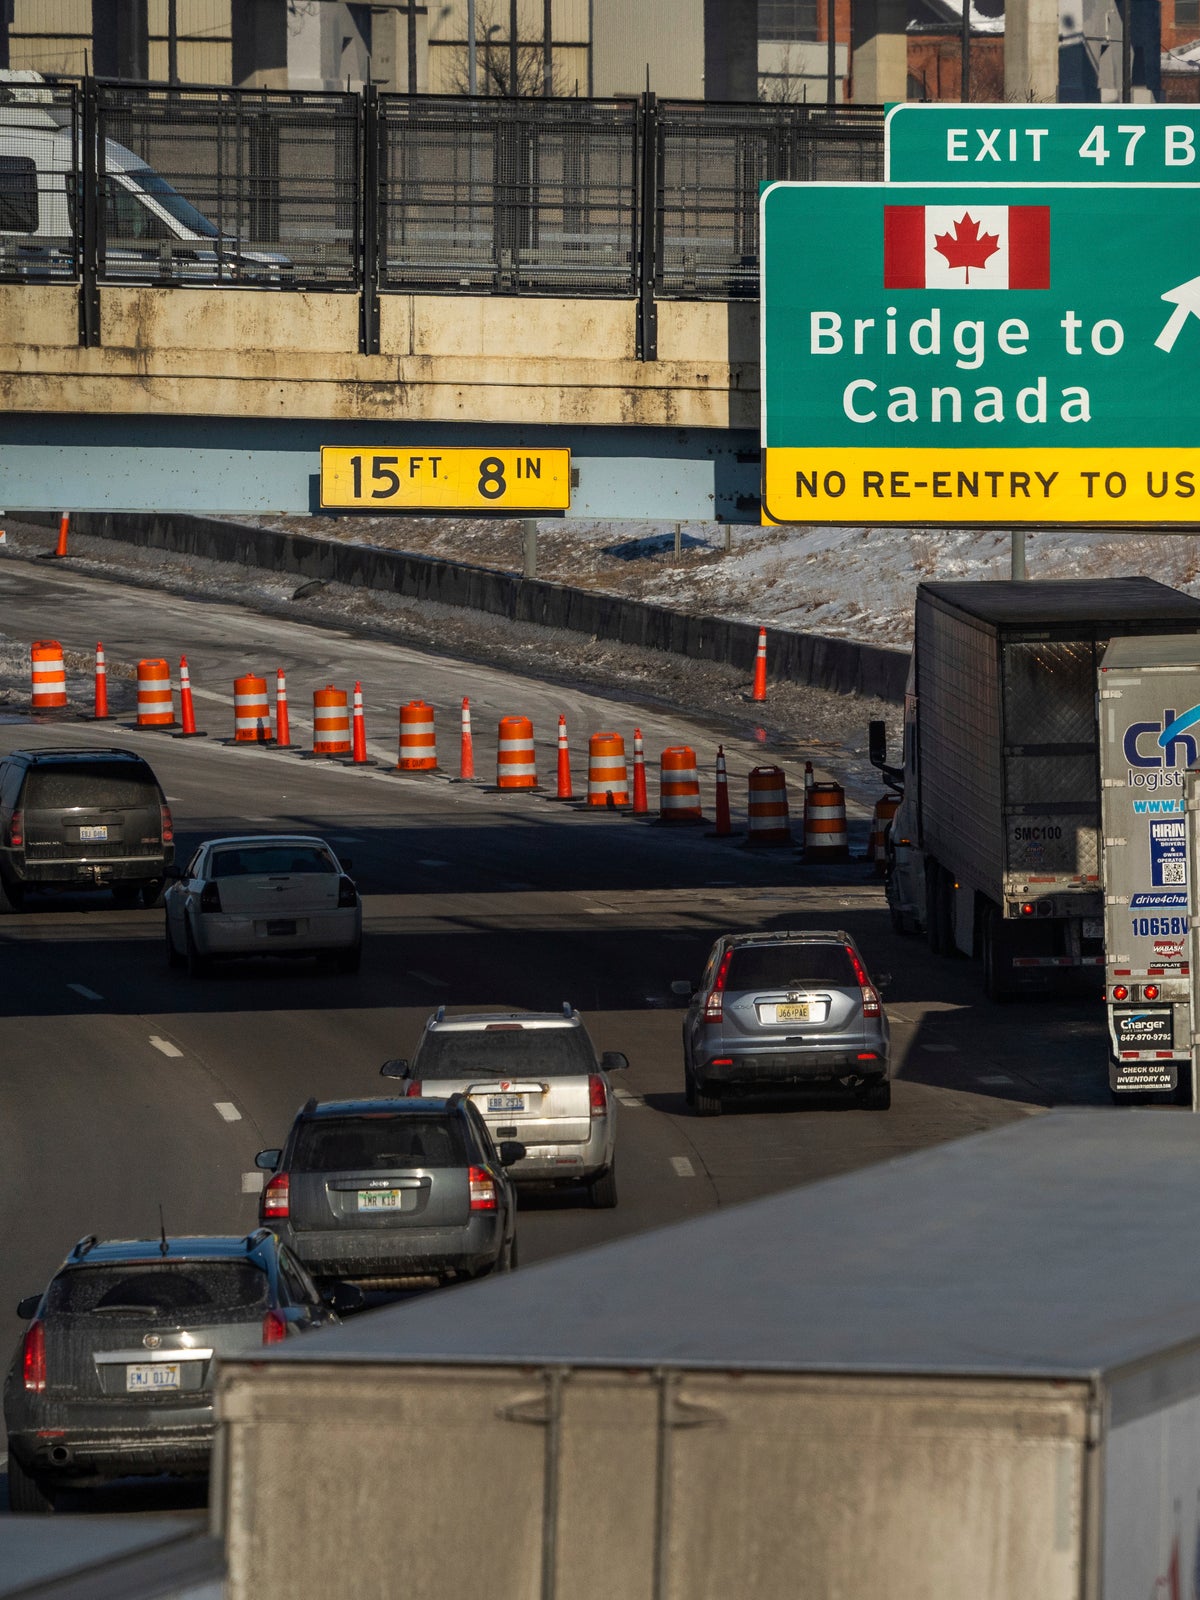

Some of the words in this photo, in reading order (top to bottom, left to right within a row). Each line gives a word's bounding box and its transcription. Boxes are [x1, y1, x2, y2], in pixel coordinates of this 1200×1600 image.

[946, 128, 1049, 162] EXIT
[1079, 125, 1147, 167] 47
[1164, 124, 1196, 166] B
[810, 306, 1030, 370] Bridge
[1060, 309, 1125, 355] to
[843, 377, 1092, 423] Canada
[796, 470, 846, 499] NO
[863, 470, 1059, 499] RE-ENTRY
[1080, 471, 1127, 499] TO
[1128, 768, 1185, 791] logist
[1014, 826, 1062, 840] SMC100
[1120, 1017, 1165, 1031] Charger
